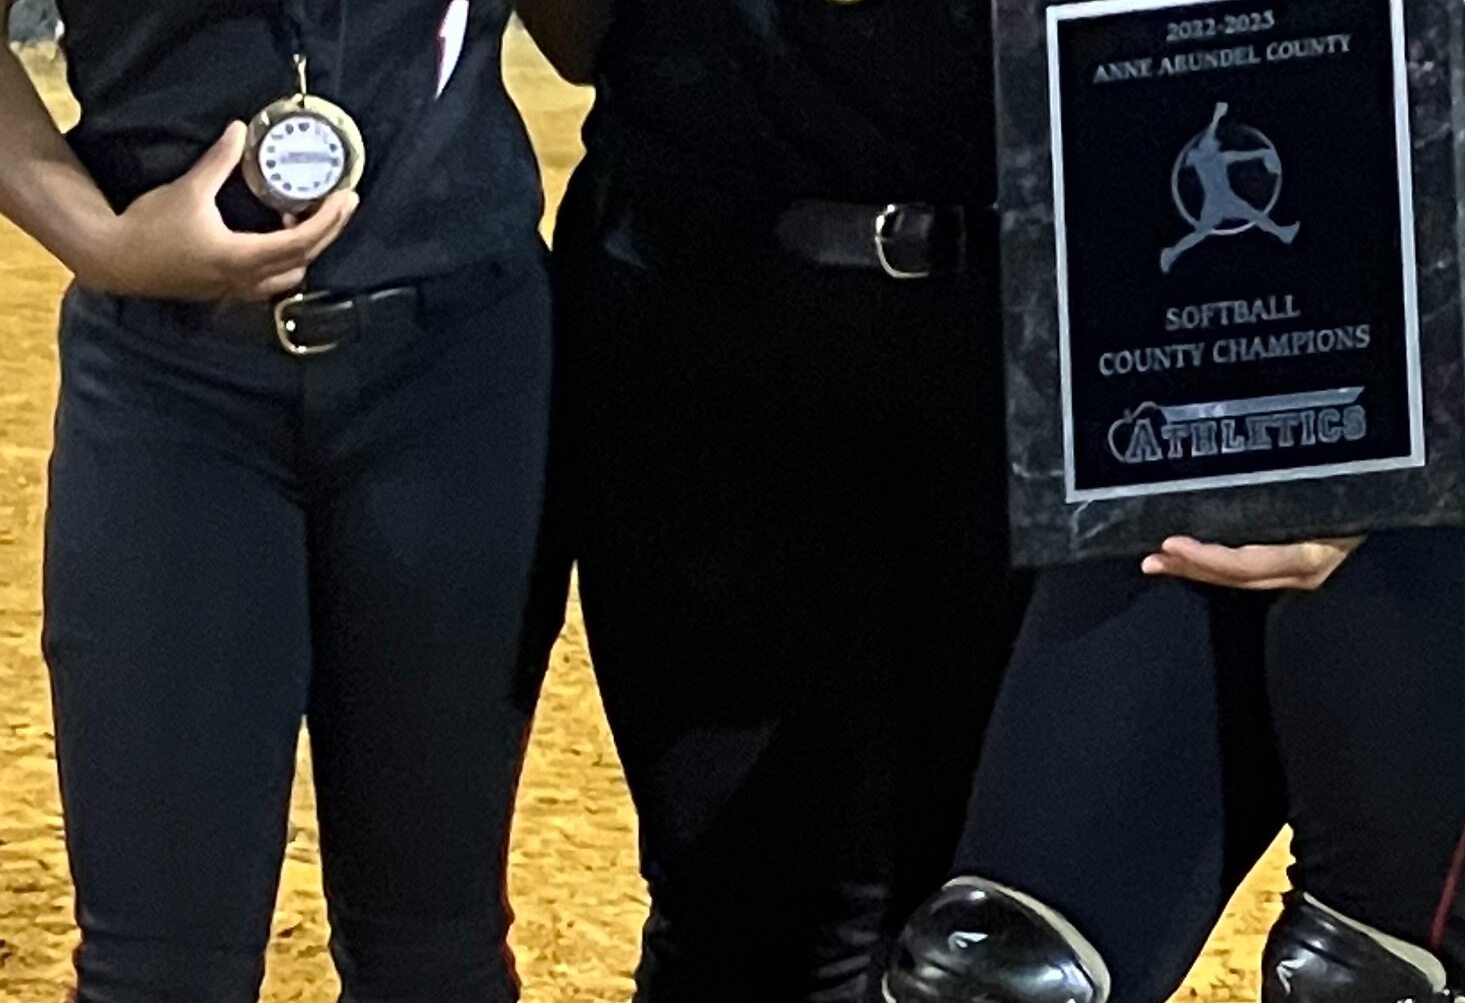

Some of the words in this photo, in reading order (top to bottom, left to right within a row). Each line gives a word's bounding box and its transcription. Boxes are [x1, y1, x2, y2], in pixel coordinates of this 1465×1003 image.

[1165, 9, 1275, 42] 2022-2023
[1093, 58, 1153, 83] ANNE
[1157, 45, 1261, 76] ARUNDEL
[1266, 33, 1351, 61] COUNTY
[1165, 294, 1301, 331] SOFTBALL
[1099, 342, 1205, 377] COUNTY
[1212, 323, 1371, 364] CHAMPIONS
[1125, 404, 1368, 464] ATHLETICS
